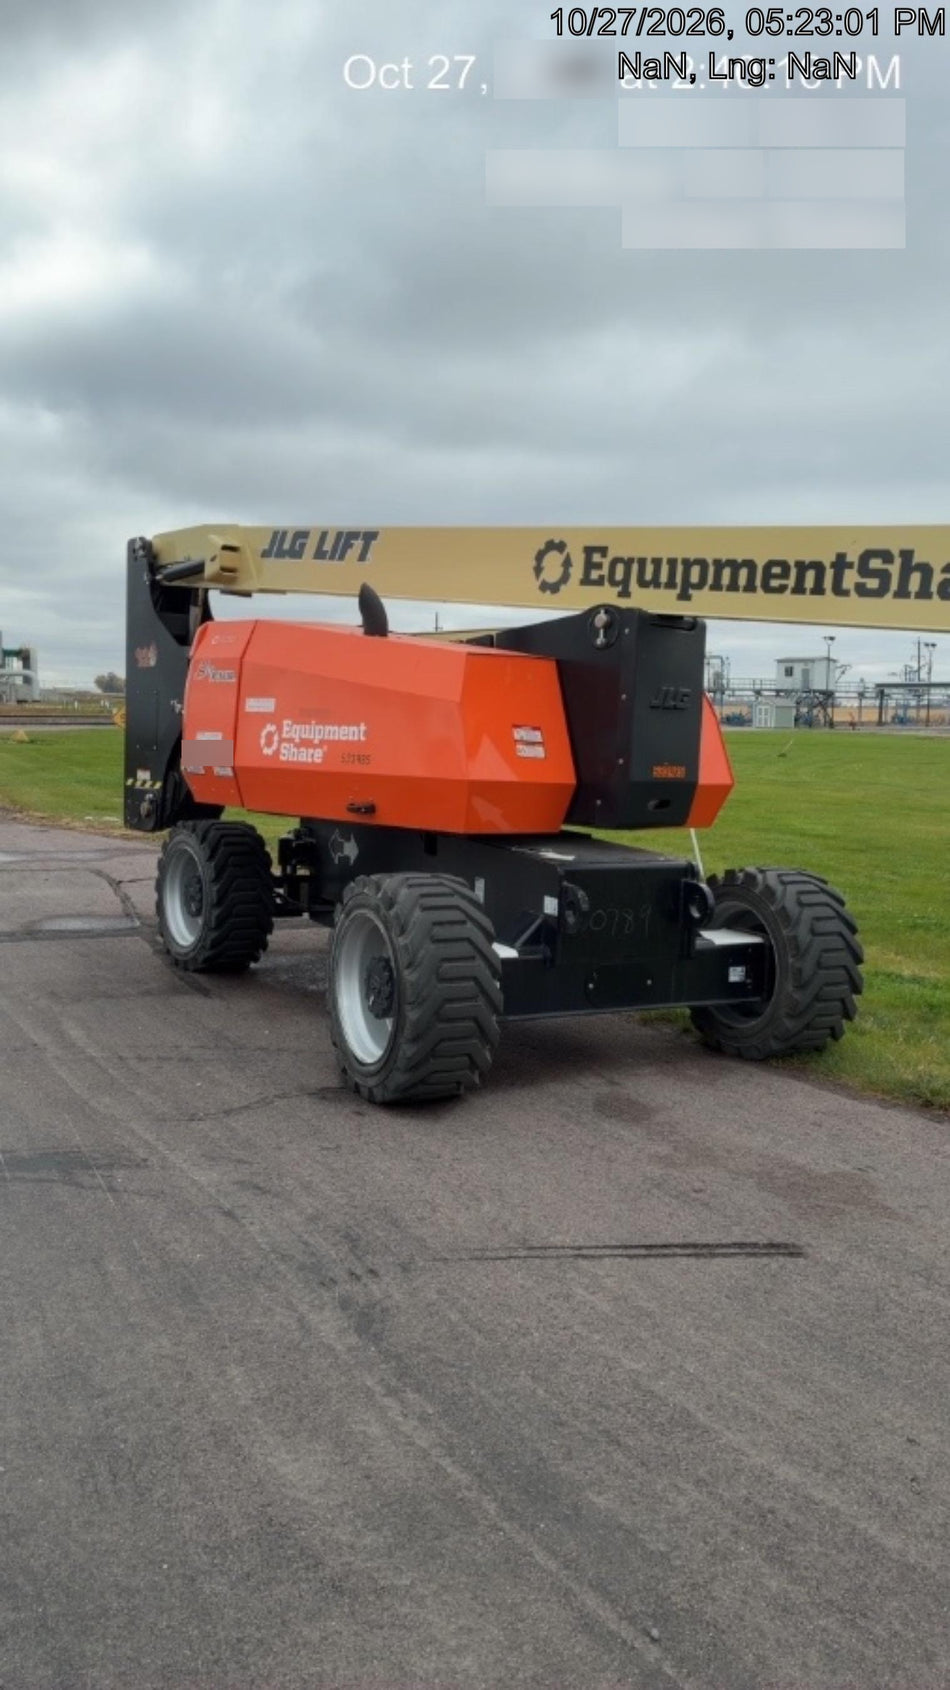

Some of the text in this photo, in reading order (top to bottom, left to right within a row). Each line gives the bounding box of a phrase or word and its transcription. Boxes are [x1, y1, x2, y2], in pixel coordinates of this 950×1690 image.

[260, 530, 380, 563] JLG LIFT
[281, 719, 368, 745] Equipment
